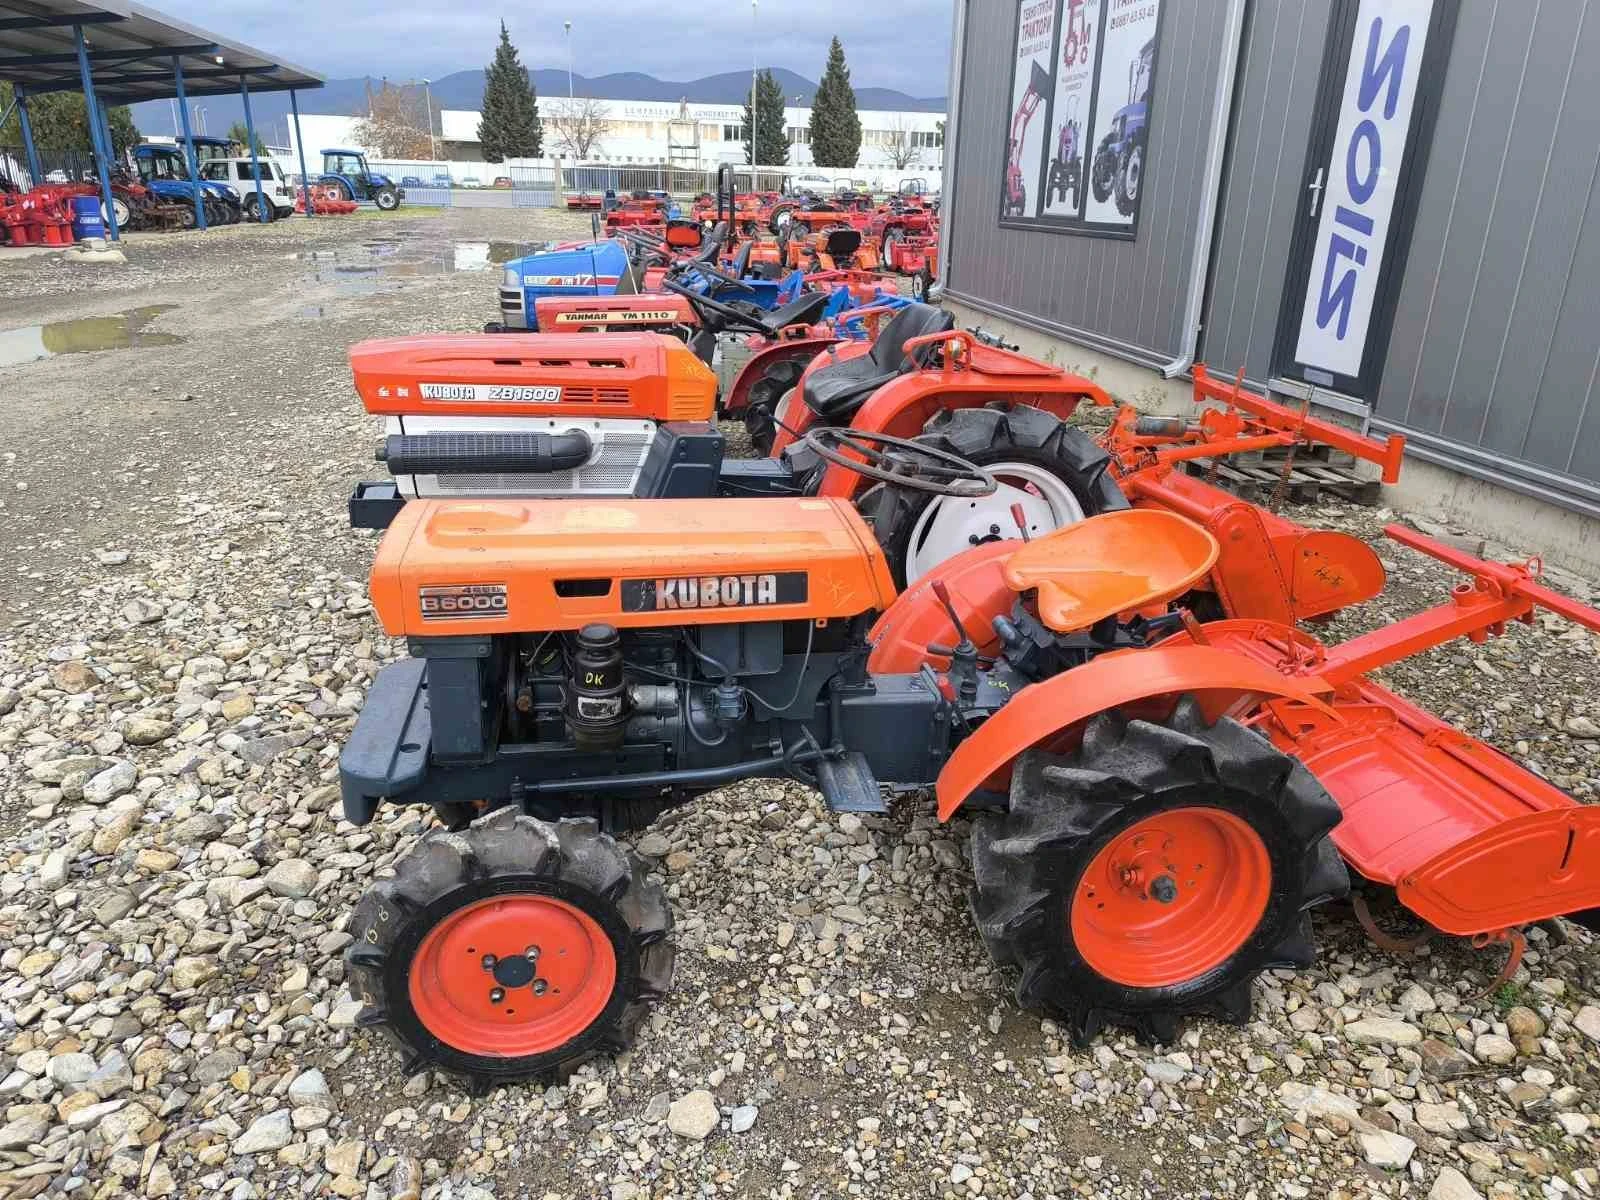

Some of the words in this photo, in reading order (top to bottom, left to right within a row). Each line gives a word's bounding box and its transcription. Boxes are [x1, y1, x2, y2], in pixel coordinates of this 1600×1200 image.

[564, 313, 608, 321] YANMAR
[423, 385, 476, 400] KUBOTA
[487, 386, 561, 401] ZB1600
[655, 574, 777, 610] KUBOTA
[421, 594, 508, 612] B6000
